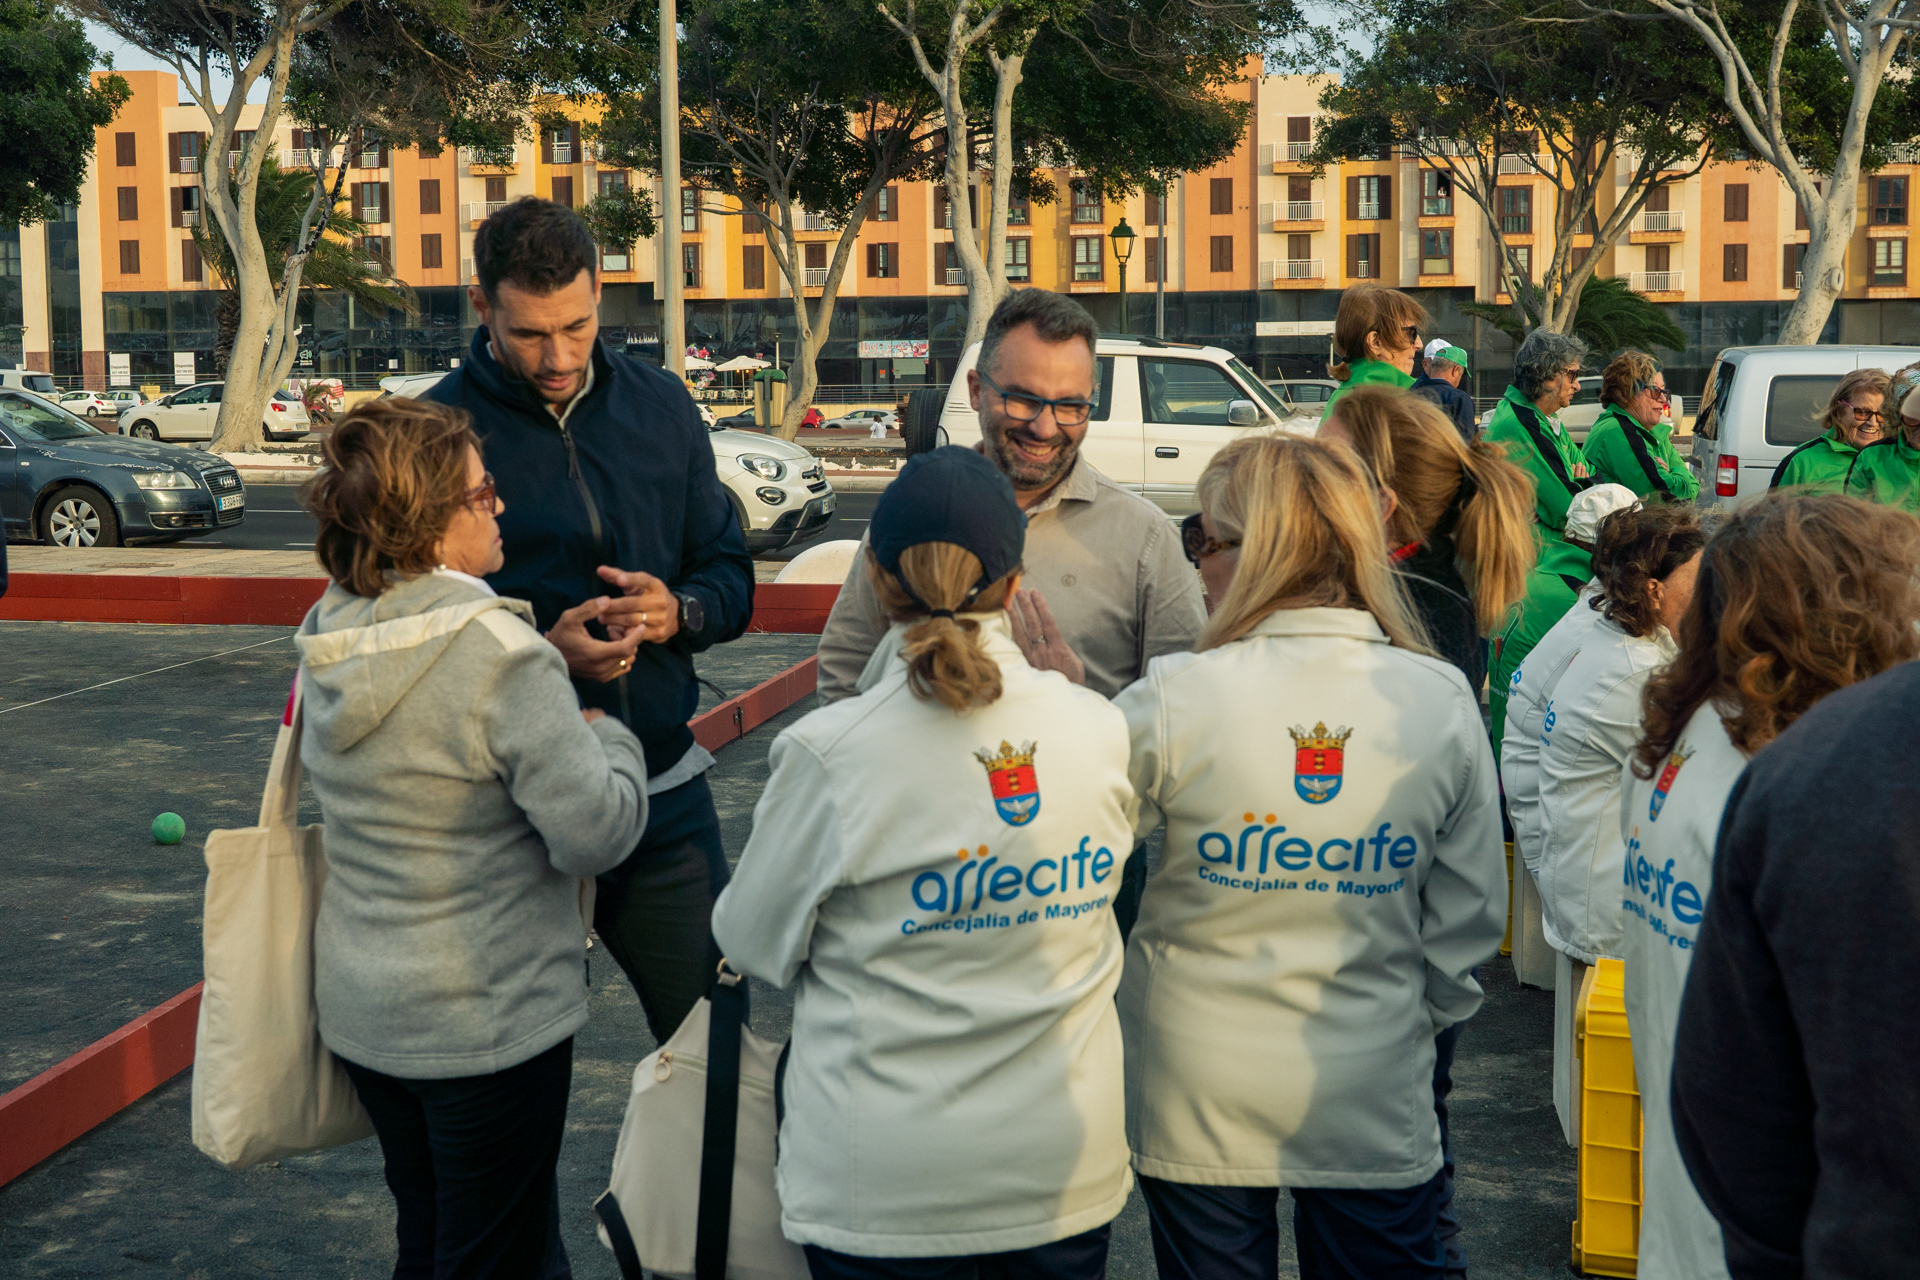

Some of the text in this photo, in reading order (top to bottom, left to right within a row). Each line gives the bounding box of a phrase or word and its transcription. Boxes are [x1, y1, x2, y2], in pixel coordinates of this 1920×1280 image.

[1197, 811, 1418, 875] arrecife
[911, 834, 1115, 916] arrecife
[1198, 865, 1299, 894] Concejalía
[1304, 879, 1330, 892] de
[901, 912, 1011, 935] Concejalía
[1016, 909, 1040, 926] de
